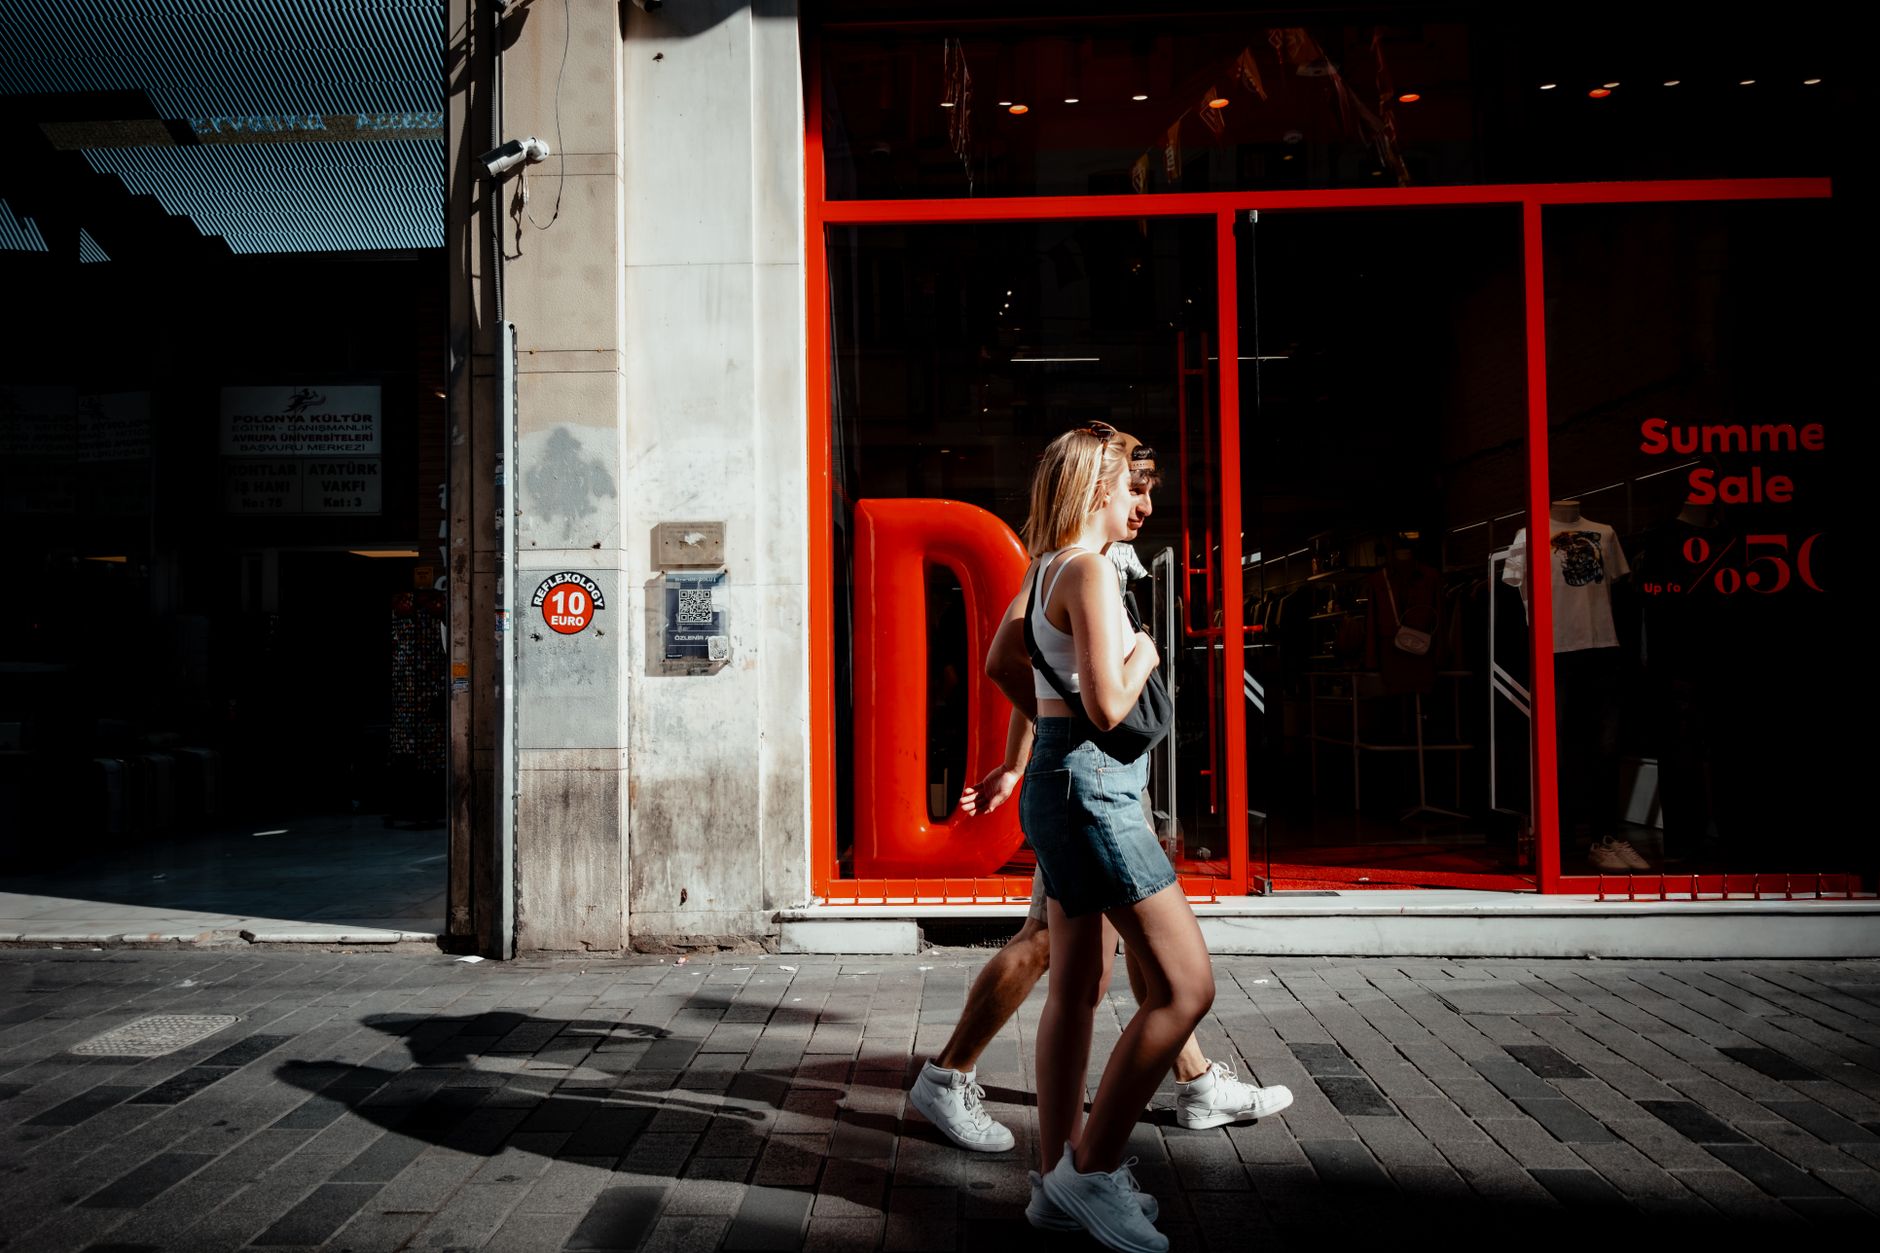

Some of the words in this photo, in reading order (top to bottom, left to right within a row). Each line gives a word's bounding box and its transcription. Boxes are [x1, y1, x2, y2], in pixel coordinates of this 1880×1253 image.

[232, 414, 305, 423] POLONYA
[310, 413, 373, 423] KÜLTÜR
[232, 434, 277, 442] AVRUPA
[280, 432, 373, 442] ÜNİVERSİTELERİ
[307, 443, 365, 451] MERKEZİ
[309, 461, 377, 475] ATATÜRK
[321, 480, 365, 492] VAKFI
[1687, 466, 1795, 505] Sale
[355, 498, 362, 507] 3
[533, 573, 604, 607] REFLEXOLOGY
[1644, 582, 1662, 596] Up
[552, 591, 585, 615] 10
[551, 615, 584, 626] EURO
